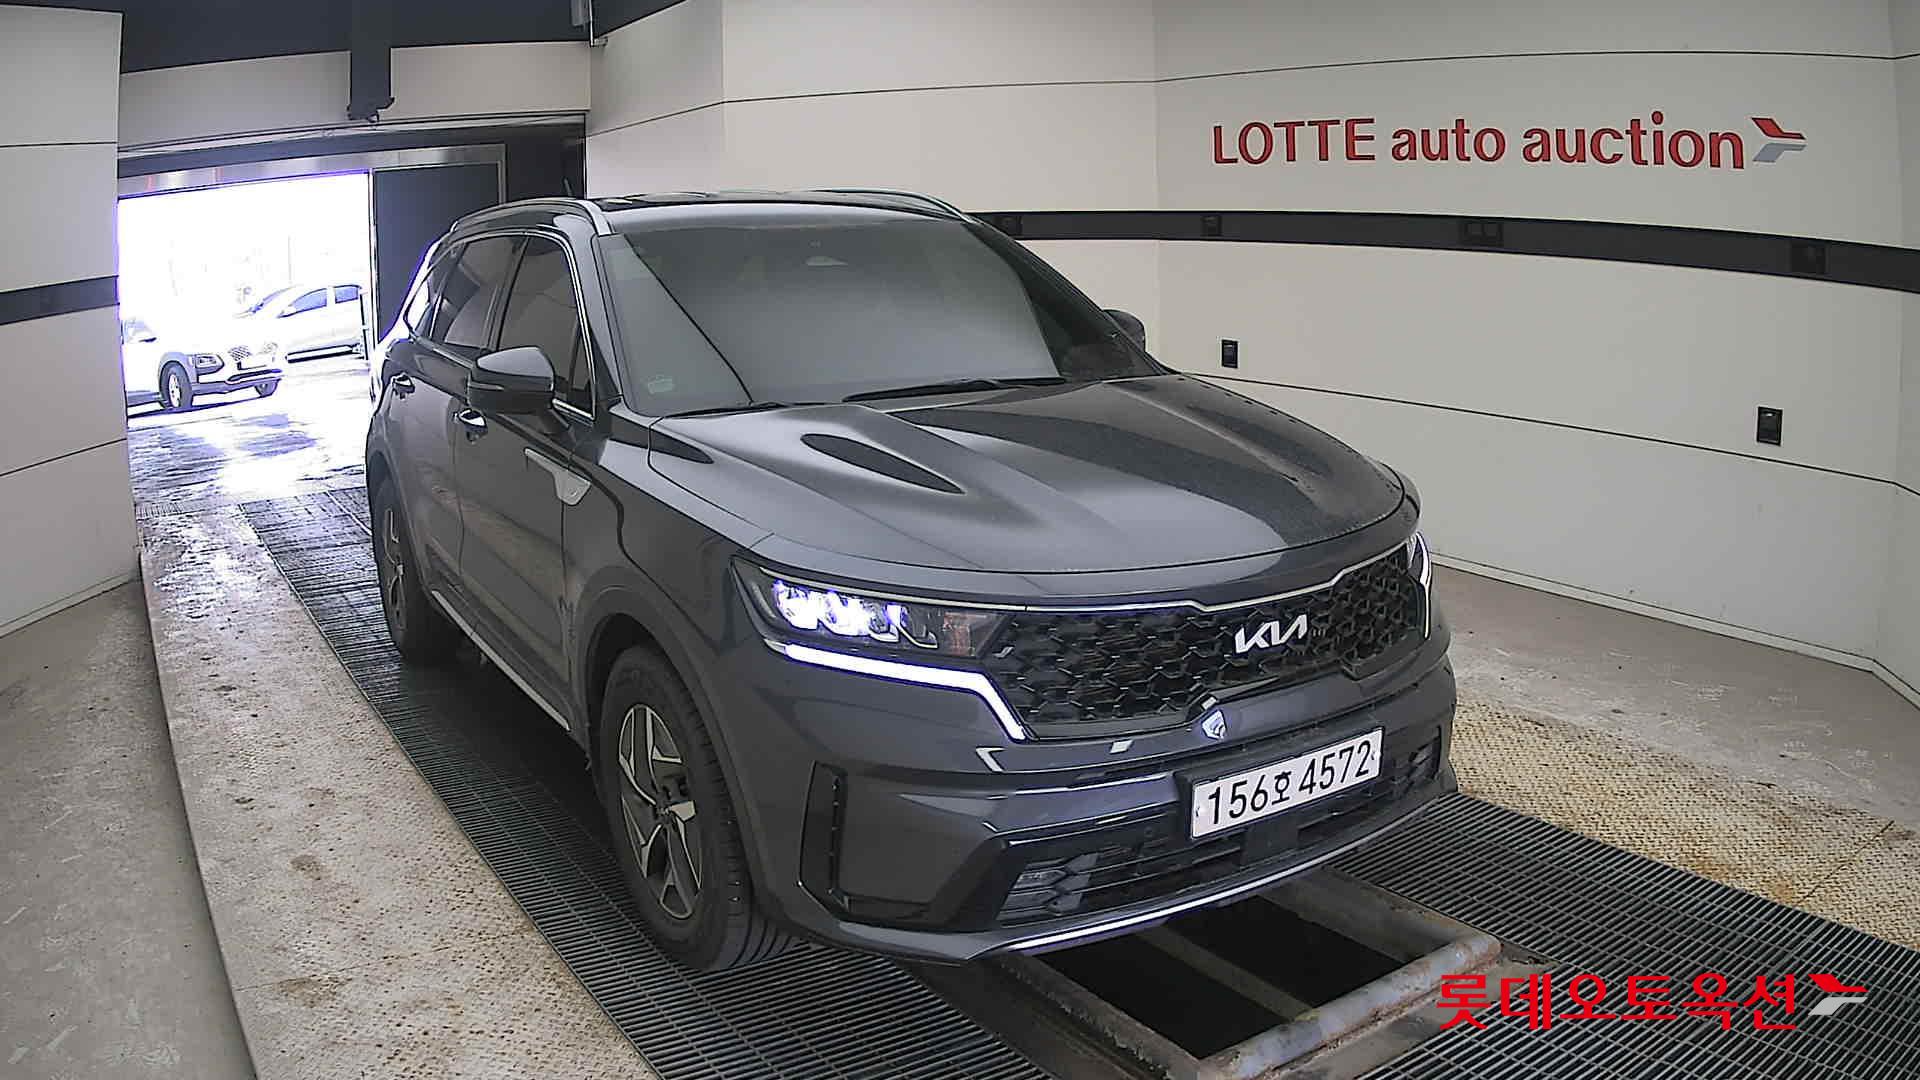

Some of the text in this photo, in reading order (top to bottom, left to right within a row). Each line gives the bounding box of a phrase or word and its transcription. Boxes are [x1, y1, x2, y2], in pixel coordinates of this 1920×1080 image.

[1213, 110, 1745, 170] LOTTE auto auction
[1234, 613, 1309, 655] KIA
[1298, 739, 1372, 795] 4572
